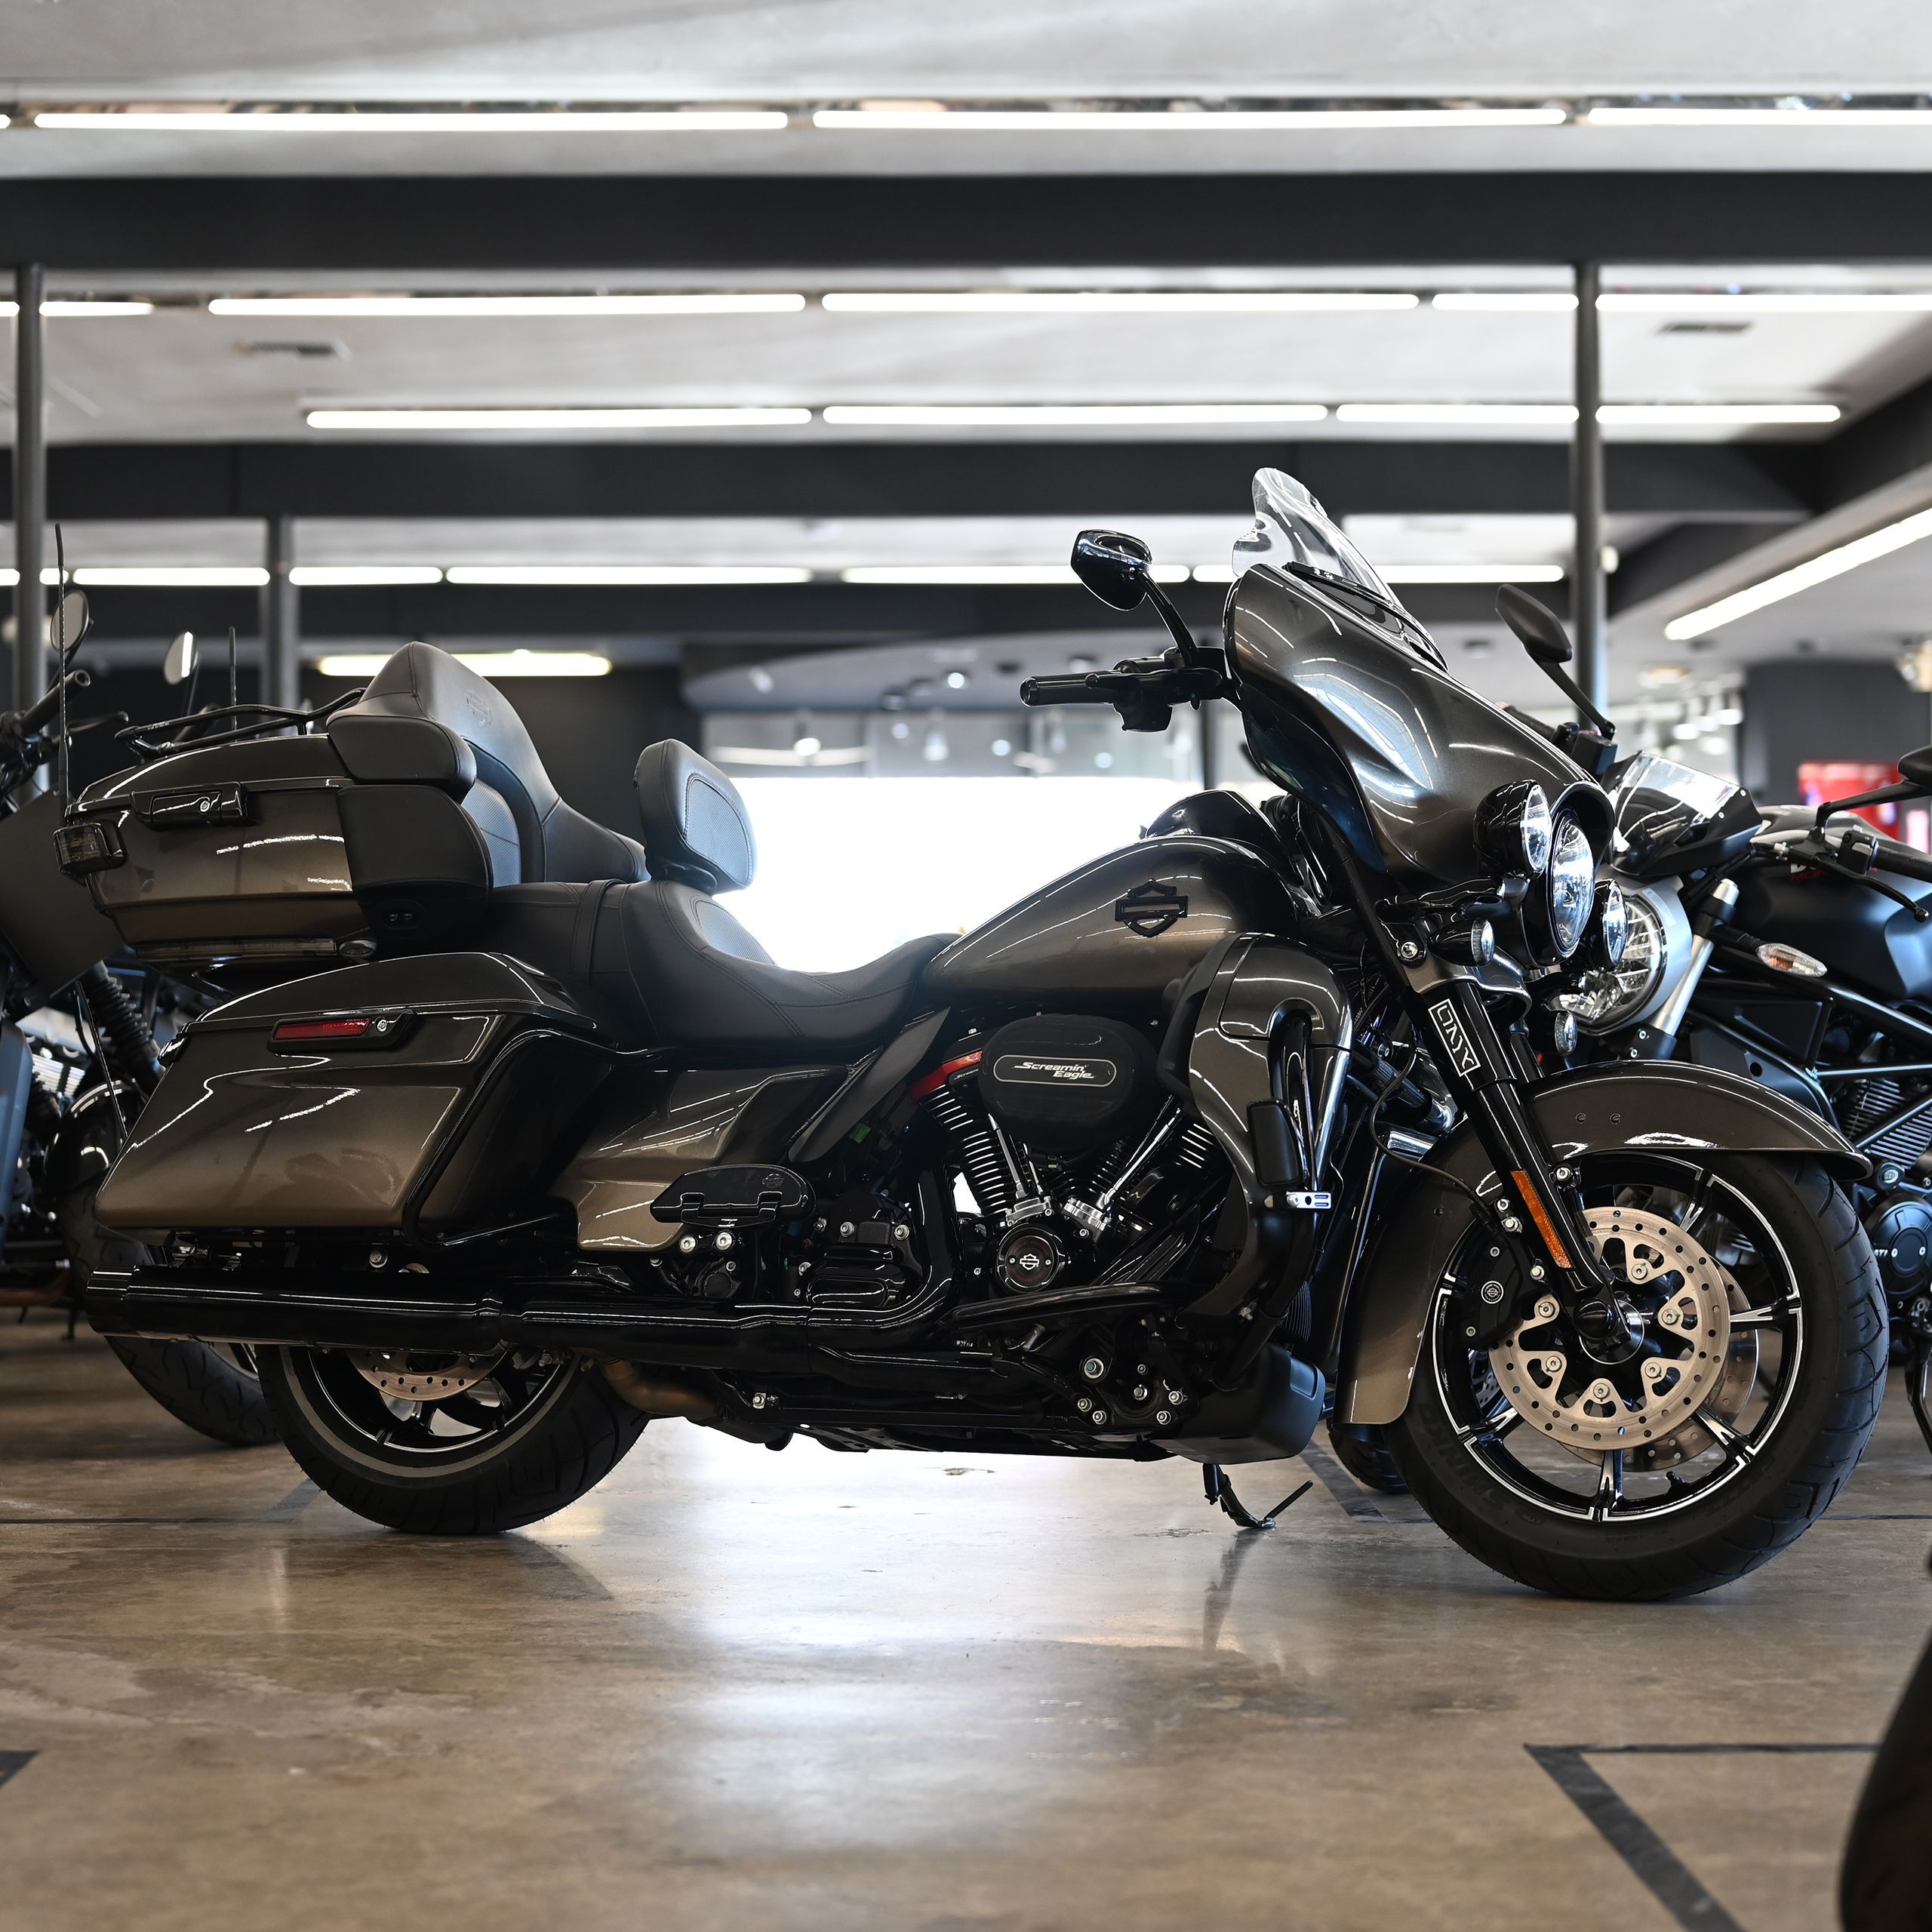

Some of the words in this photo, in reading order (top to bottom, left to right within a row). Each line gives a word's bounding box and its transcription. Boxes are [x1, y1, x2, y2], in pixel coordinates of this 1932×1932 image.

[1437, 1004, 1475, 1069] ONYX
[1014, 1062, 1087, 1072] Screamin'
[1053, 1070, 1094, 1080] Eagle
